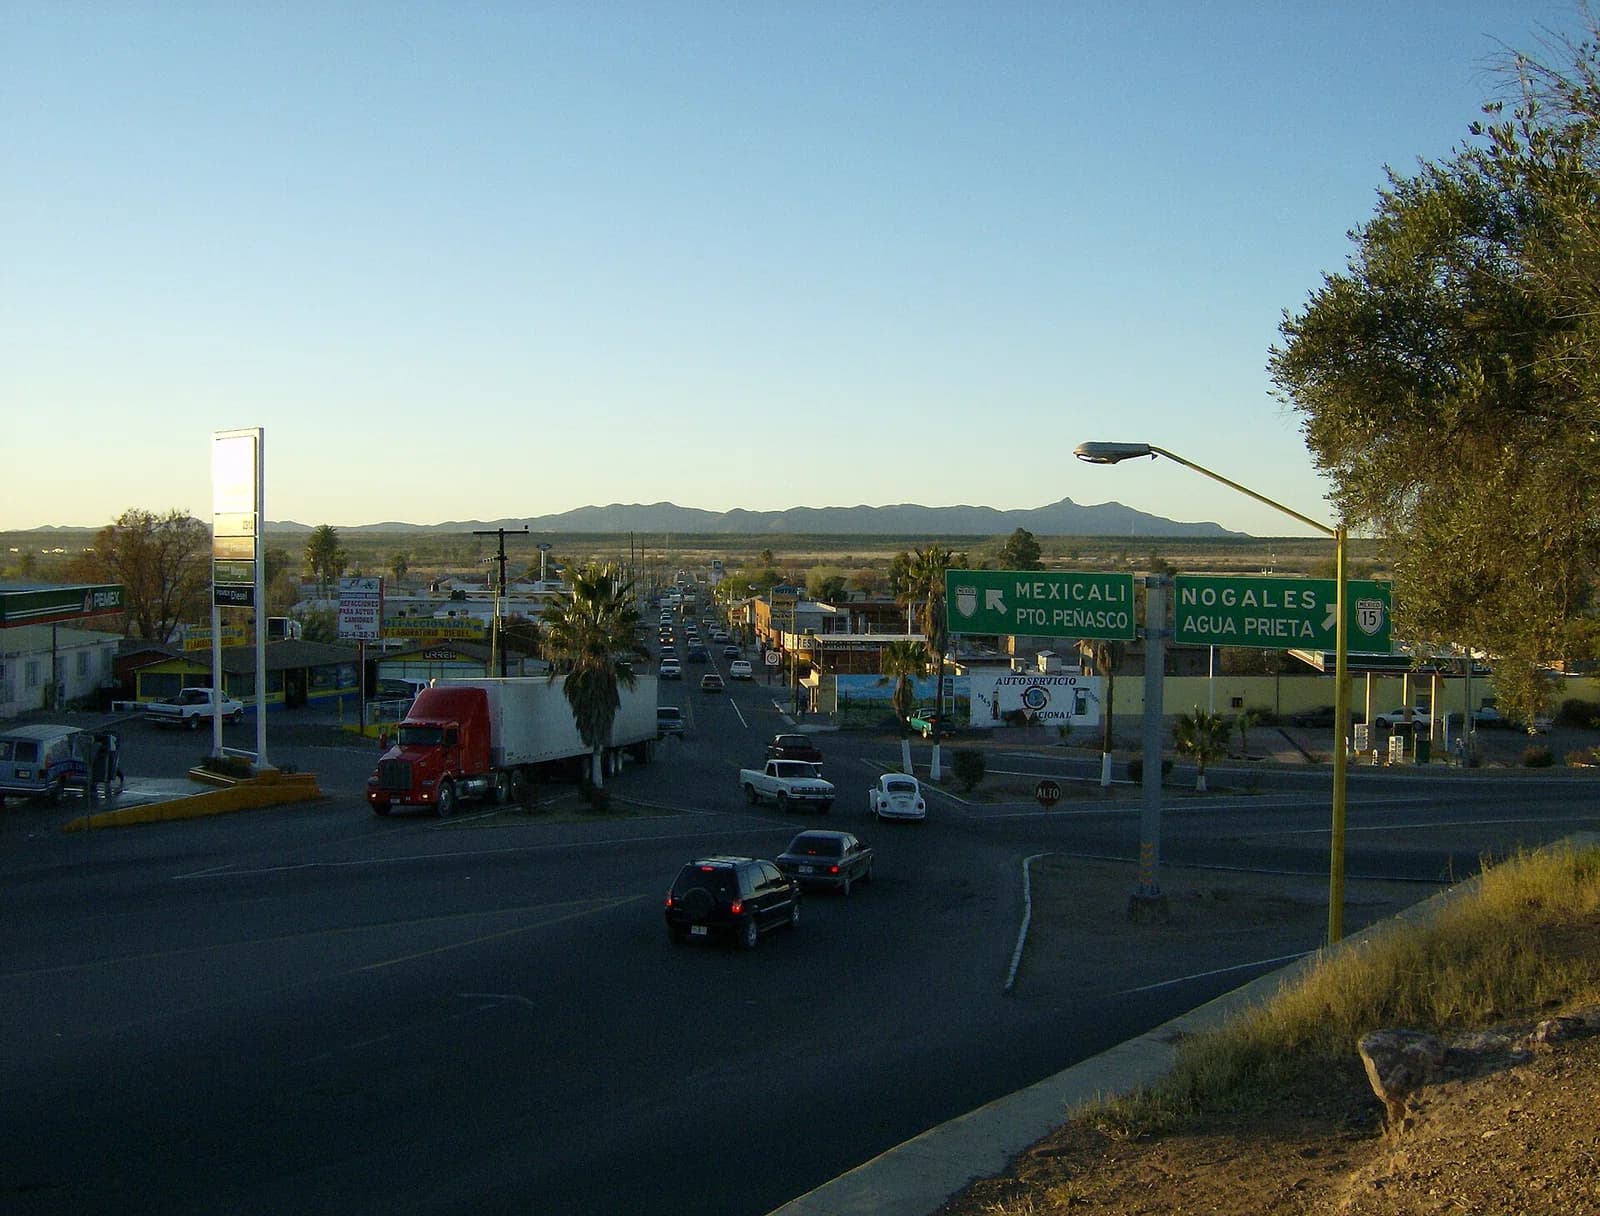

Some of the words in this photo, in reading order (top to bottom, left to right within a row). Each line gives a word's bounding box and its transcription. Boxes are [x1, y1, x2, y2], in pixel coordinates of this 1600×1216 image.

[94, 591, 120, 607] PEMEX
[1015, 582, 1125, 602] MEXICALI
[1181, 587, 1317, 610] NOGALES
[1016, 608, 1049, 626] PTO.
[1053, 607, 1128, 629] PEÑASCO
[1363, 611, 1377, 626] 15
[1183, 615, 1237, 635] AGUA
[1244, 617, 1315, 638] PRIETA
[995, 677, 1077, 686] AUTOSERVICIO
[1033, 711, 1072, 720] ACIONAL
[1036, 787, 1060, 800] ALTO
